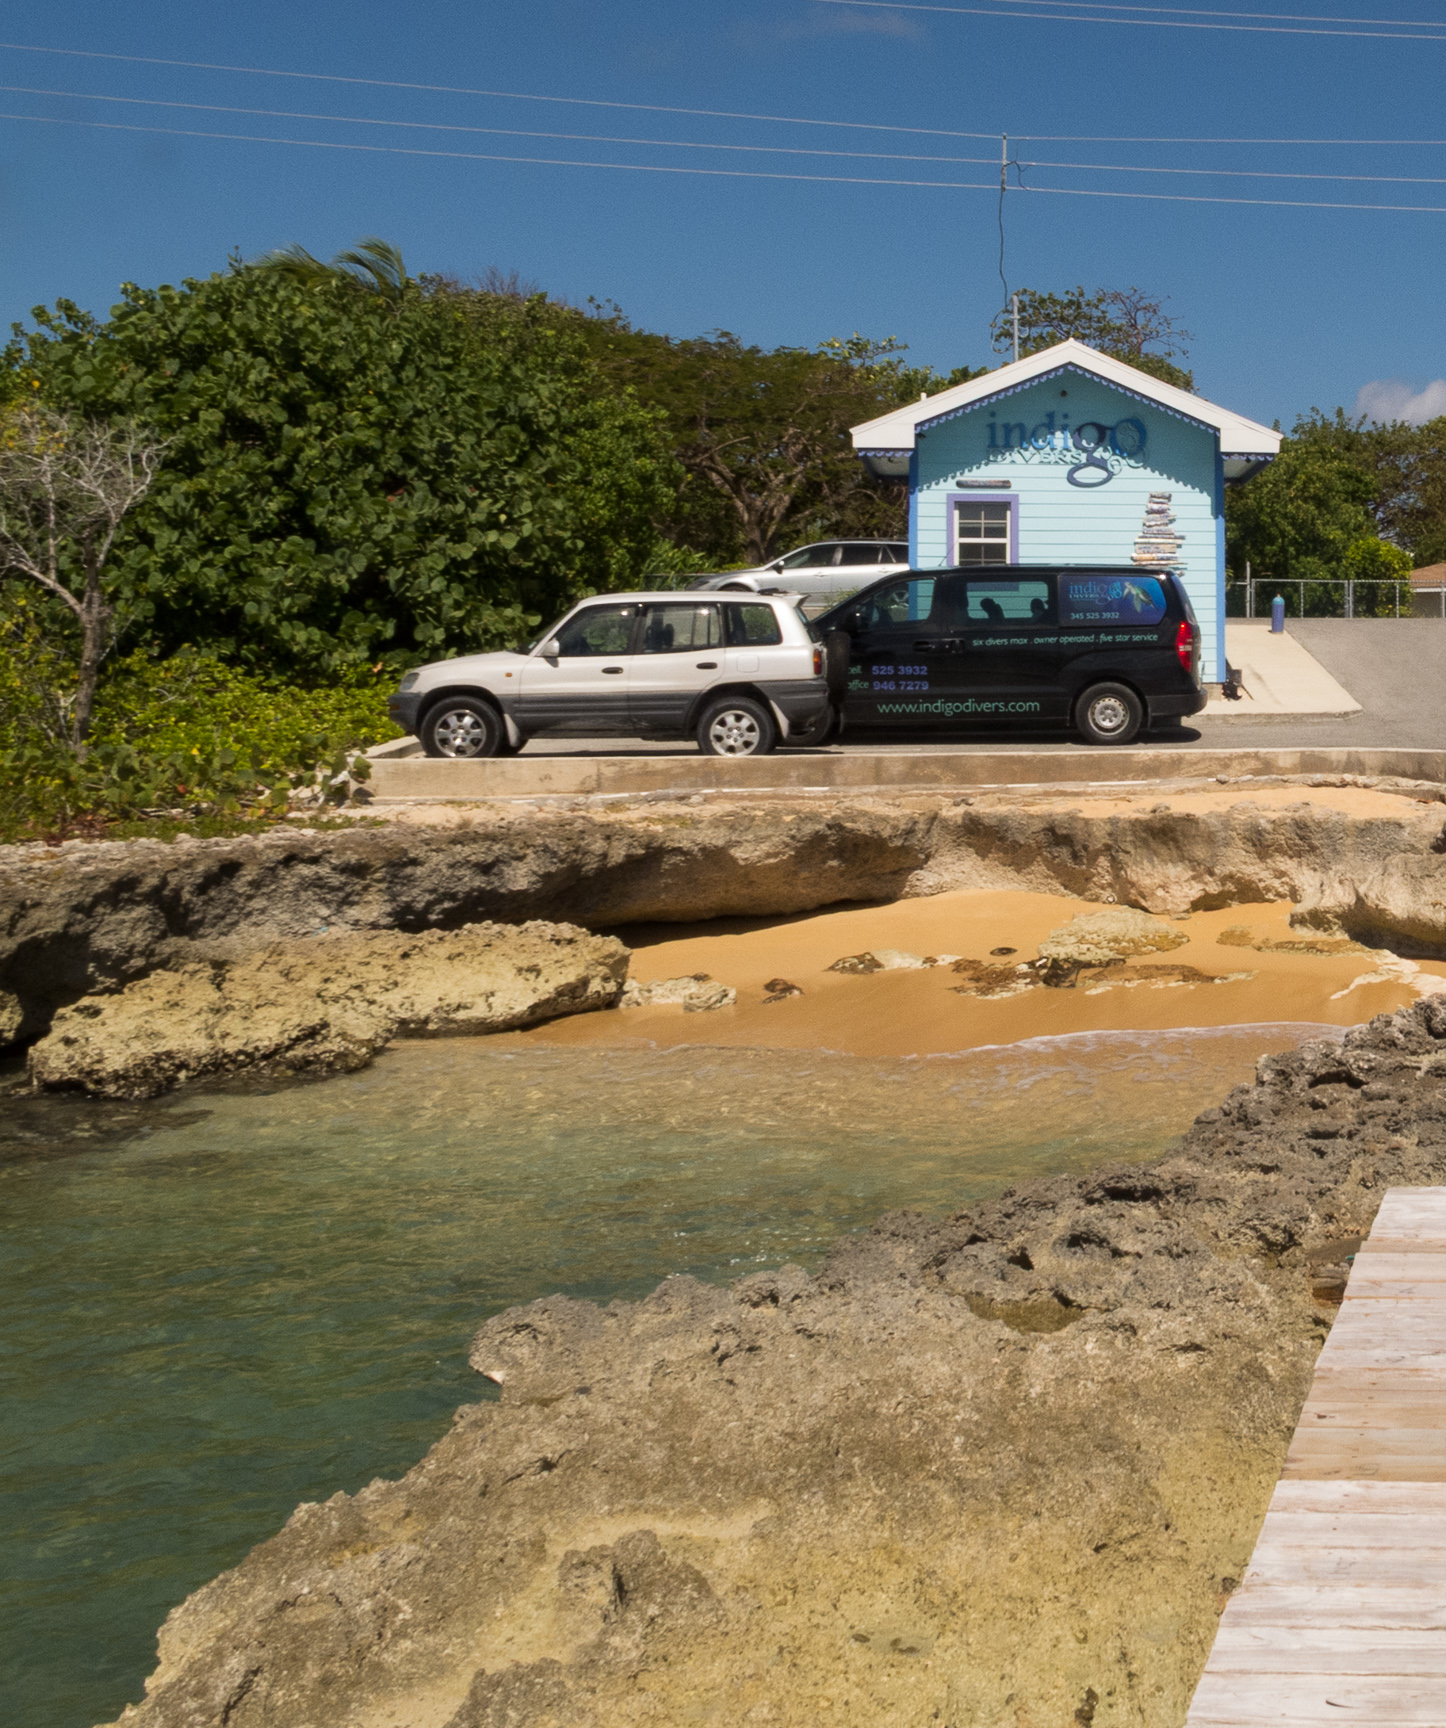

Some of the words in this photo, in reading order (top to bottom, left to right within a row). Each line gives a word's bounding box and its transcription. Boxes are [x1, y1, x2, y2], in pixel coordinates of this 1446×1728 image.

[986, 411, 1147, 488] indigo
[1069, 580, 1122, 605] indigo
[1070, 612, 1084, 620] 345
[1102, 611, 1120, 619] 3932
[972, 638, 984, 647] six
[985, 637, 1008, 646] divers
[1059, 634, 1095, 647] operated
[1098, 633, 1113, 644] five
[1114, 634, 1130, 642] star
[1131, 633, 1159, 642] service
[872, 665, 894, 675] 525
[897, 665, 928, 675] 3932
[873, 680, 896, 690] 946
[899, 680, 929, 691] 7279
[877, 699, 1040, 717] www.indigodivers.com
